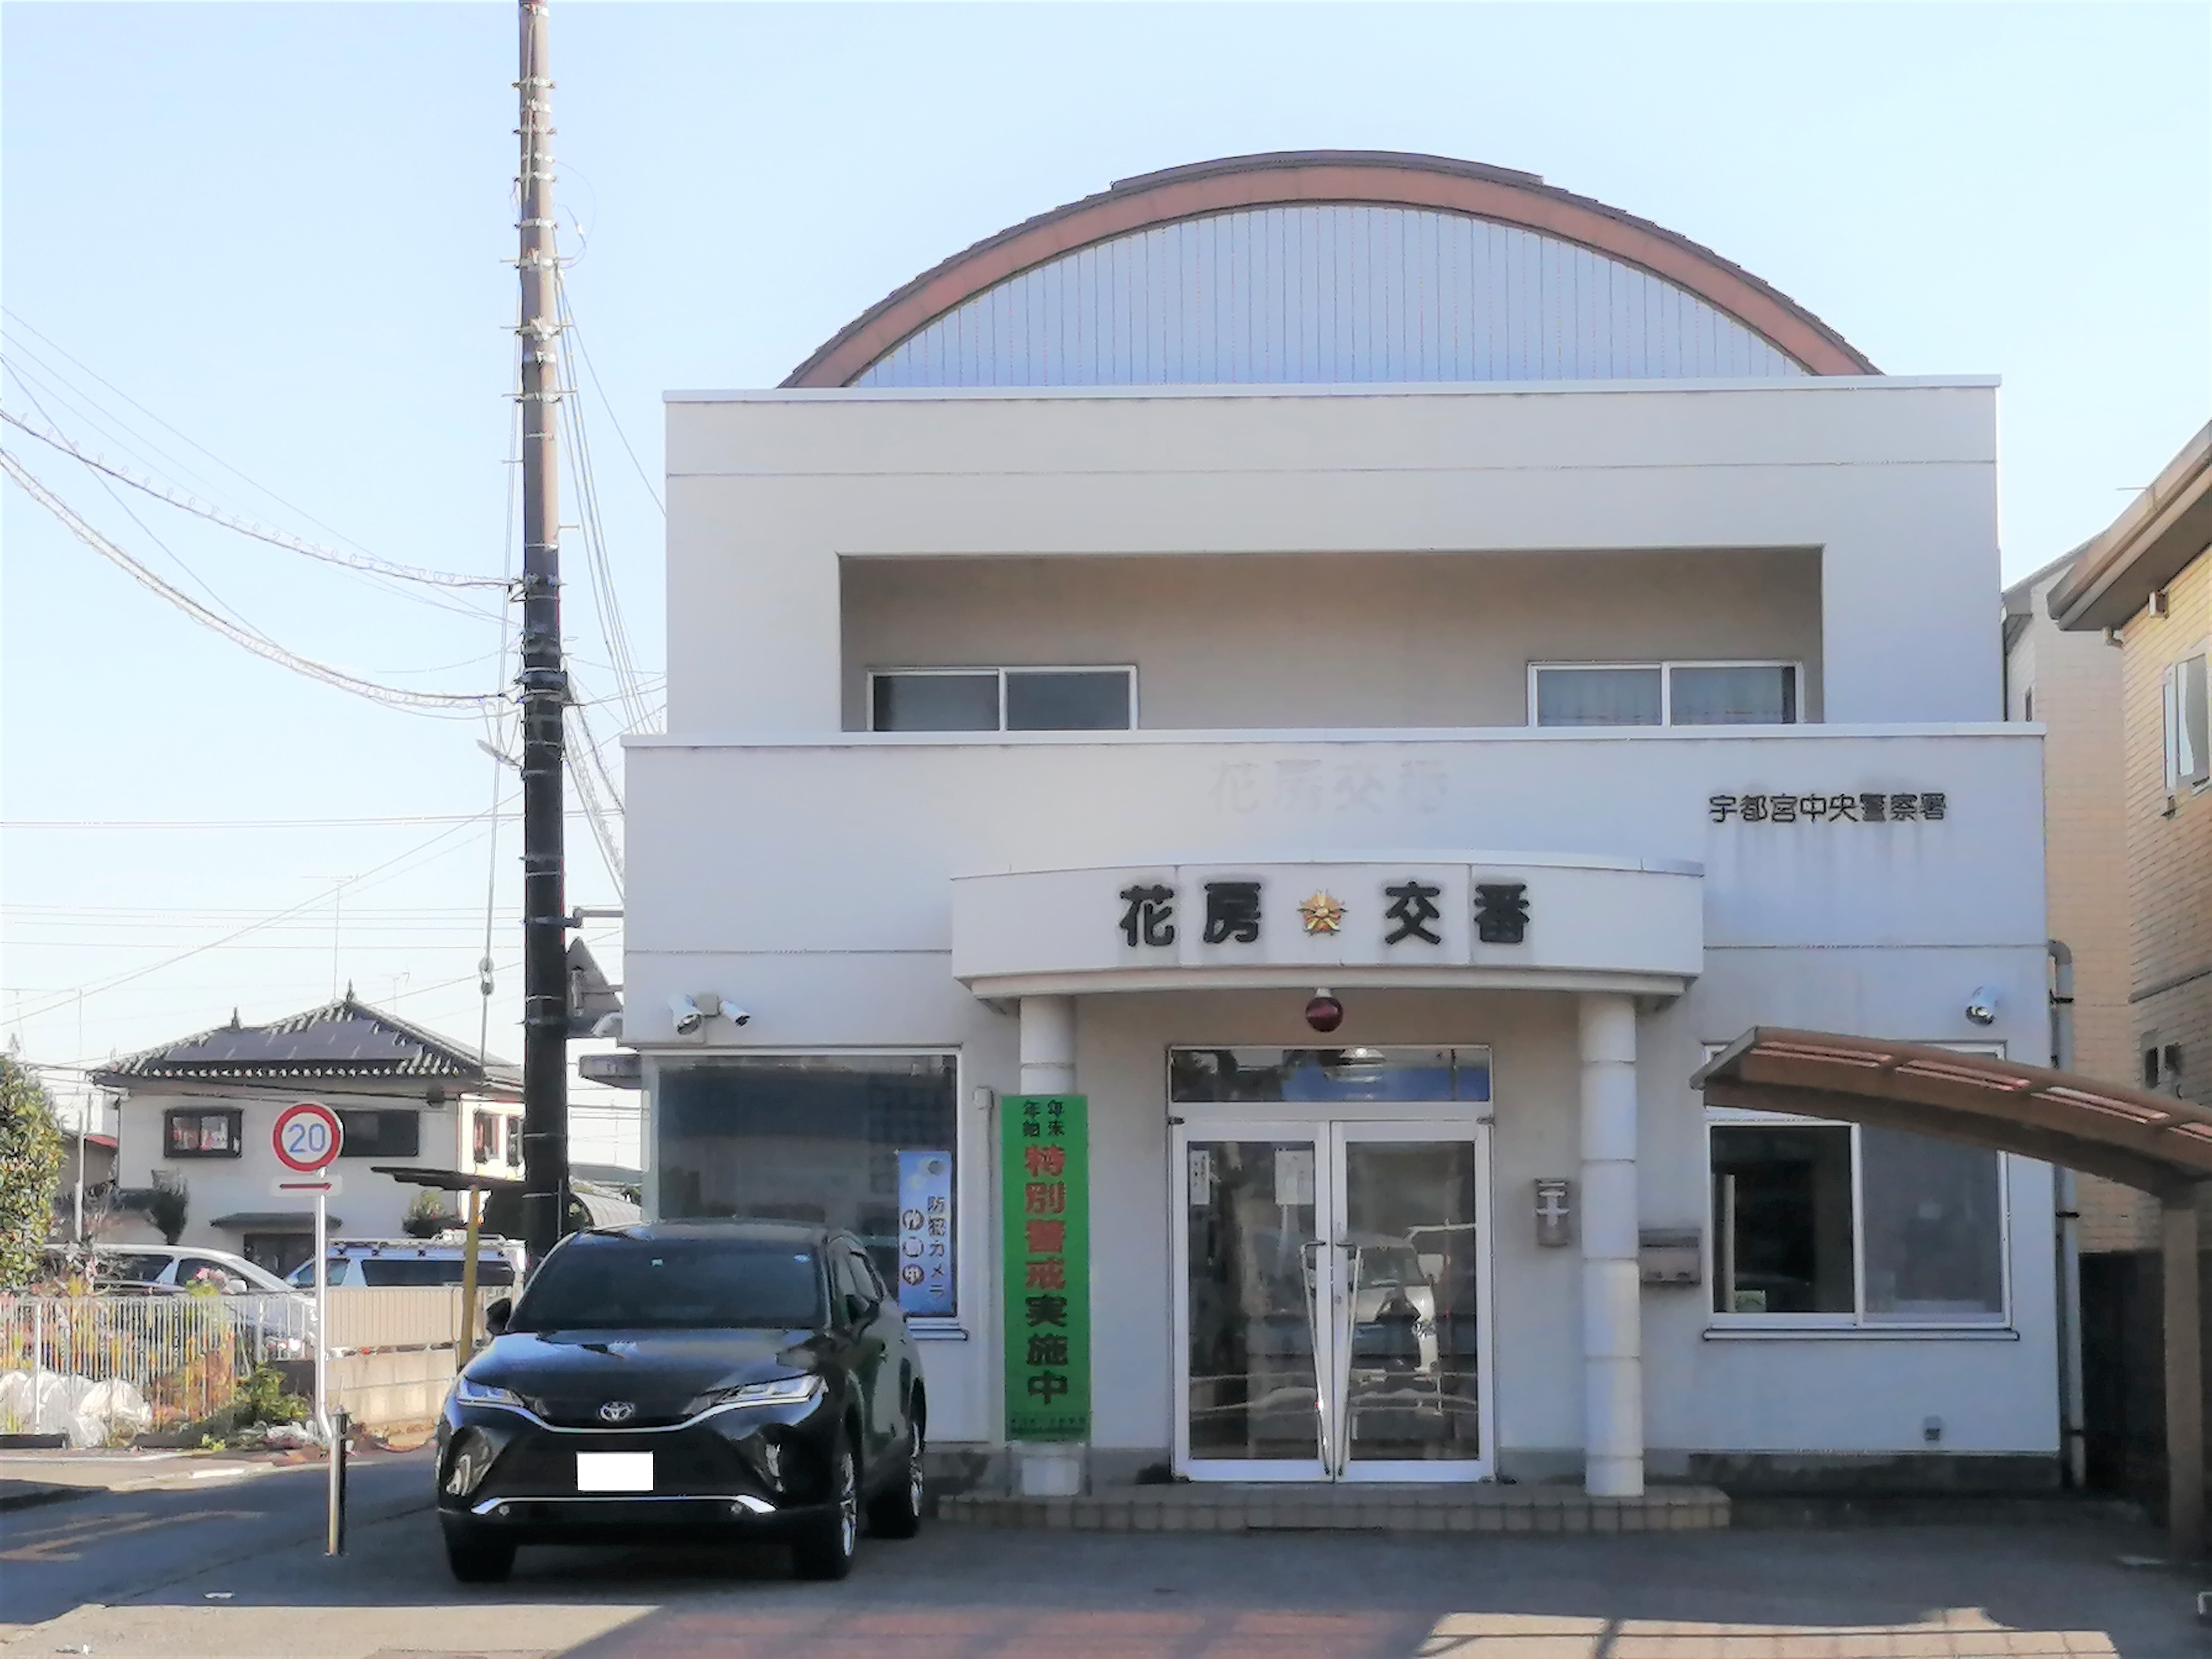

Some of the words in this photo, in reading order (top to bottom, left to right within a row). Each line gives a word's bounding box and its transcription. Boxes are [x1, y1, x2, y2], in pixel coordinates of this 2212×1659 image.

[1119, 882, 1262, 947] 花房
[1384, 881, 1531, 946] 交番
[288, 1123, 326, 1153] 20
